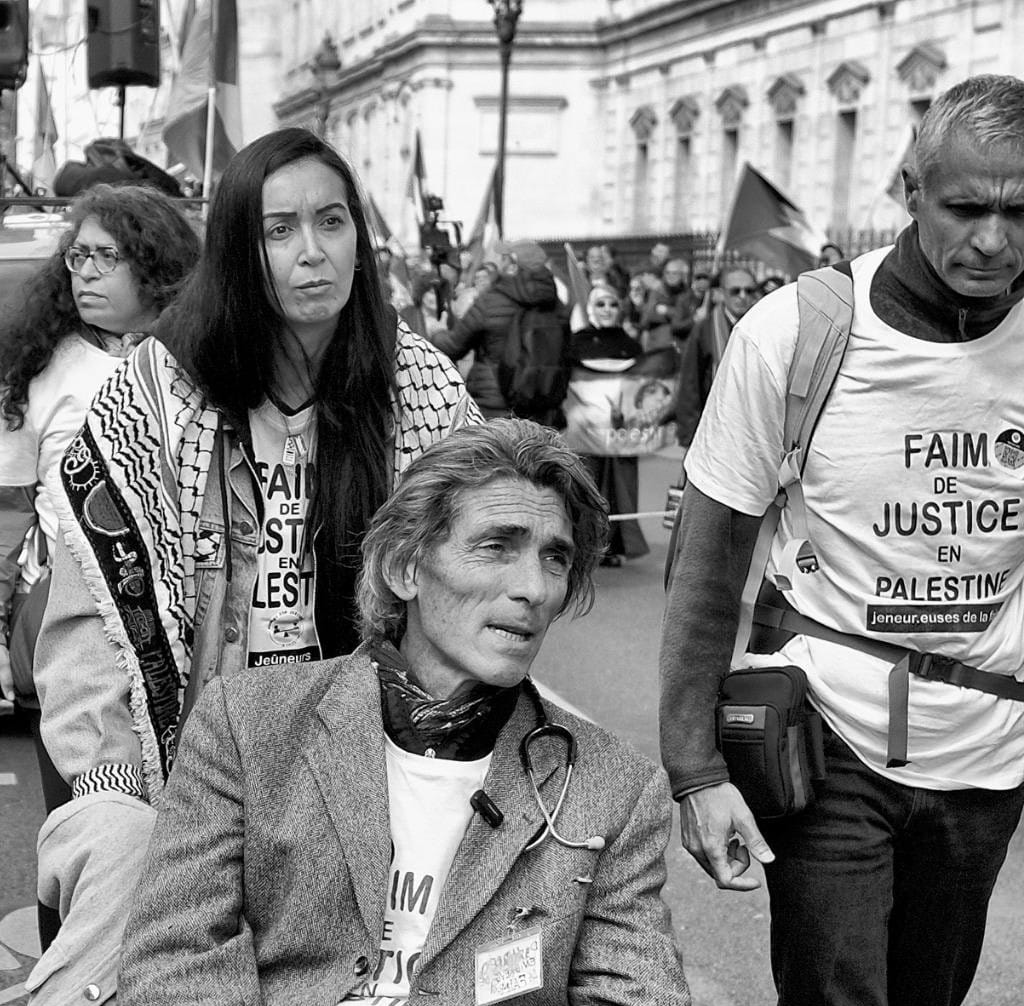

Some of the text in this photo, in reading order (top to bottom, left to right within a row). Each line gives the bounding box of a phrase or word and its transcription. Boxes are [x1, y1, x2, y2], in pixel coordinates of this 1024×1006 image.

[905, 432, 988, 469] FAIM
[934, 476, 957, 494] DE
[279, 503, 300, 515] DE
[873, 499, 1020, 537] JUSTICE
[938, 545, 961, 562] EN
[278, 557, 300, 569] EN
[962, 610, 977, 624] de
[979, 610, 988, 623] la
[390, 869, 434, 915] IM
[381, 920, 394, 940] E
